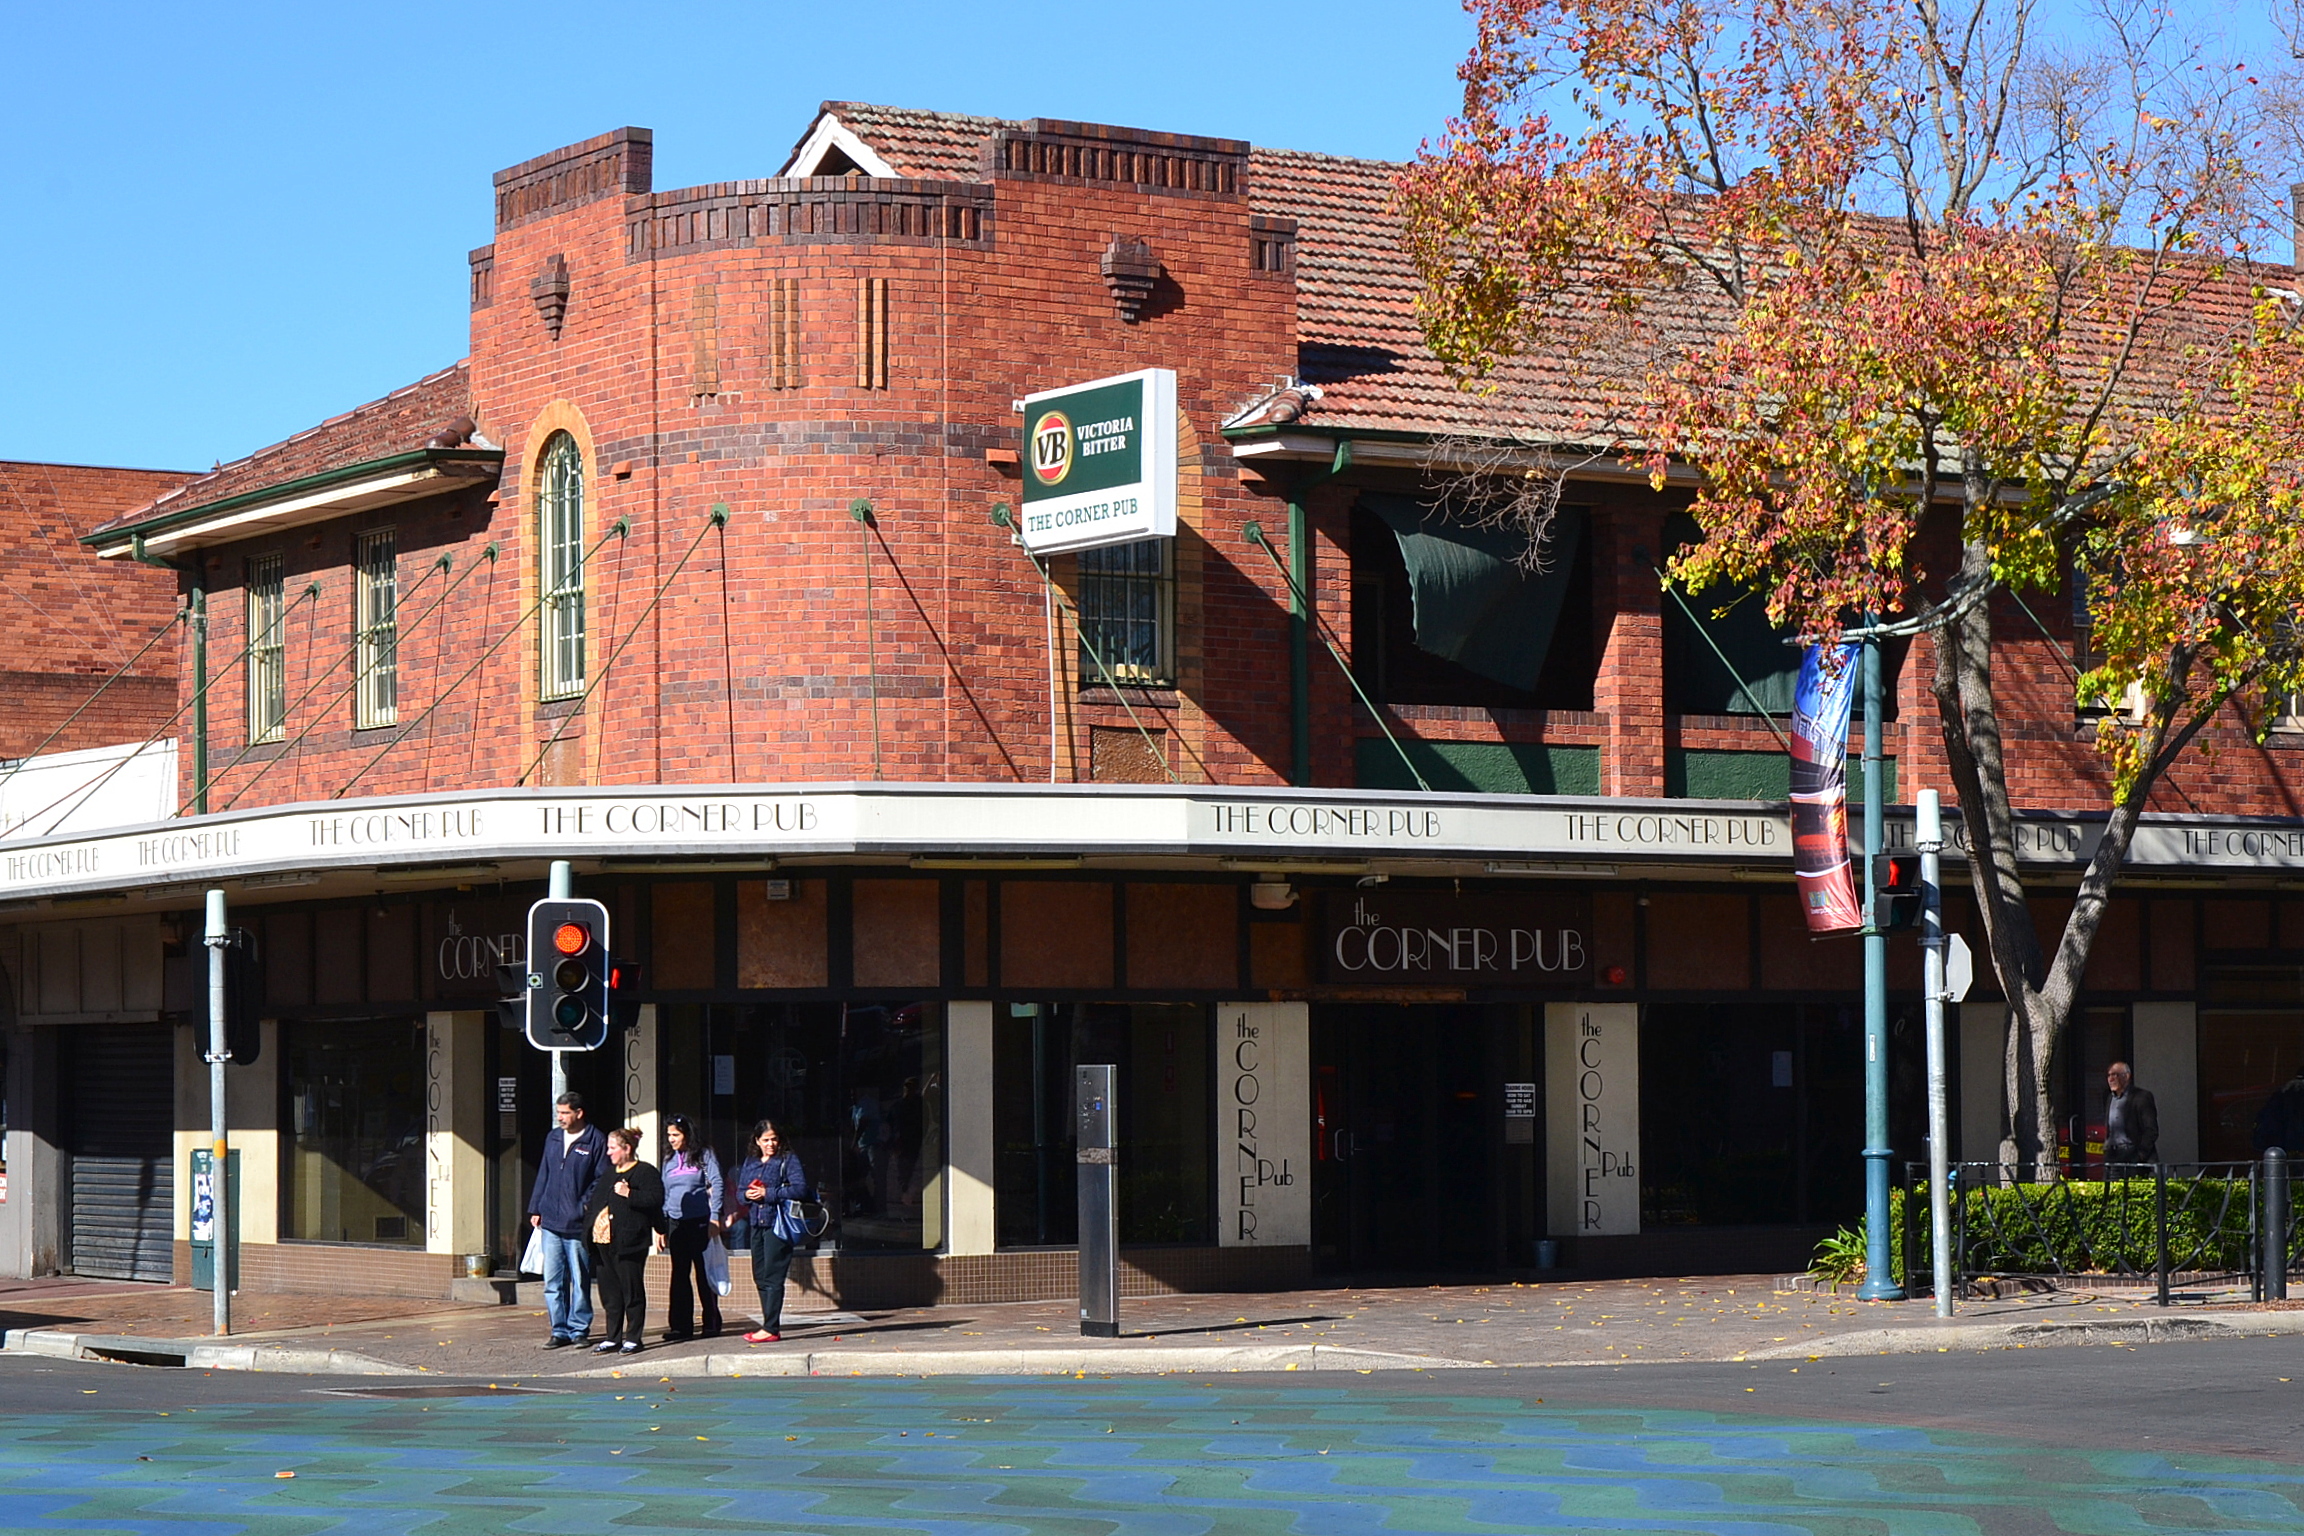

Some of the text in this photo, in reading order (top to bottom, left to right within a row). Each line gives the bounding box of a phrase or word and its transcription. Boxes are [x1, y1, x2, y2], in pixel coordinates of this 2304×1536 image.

[1077, 416, 1134, 441] VICTORIA
[1036, 430, 1067, 466] VB
[1082, 435, 1126, 457] BITTER
[1028, 498, 1138, 532] THE CORNER PUB
[309, 809, 484, 846] THE CORNER PUB
[537, 803, 817, 834] THE CORNER PUB
[1211, 805, 1441, 838] THE CORNER PUB
[1564, 814, 1775, 846] THE CORNER PUB
[1886, 823, 1915, 848] TH
[2037, 826, 2080, 852] PUB
[2182, 830, 2219, 855] THE
[7, 855, 26, 880] THE
[138, 840, 158, 866] THE
[448, 908, 462, 936] the
[1354, 897, 1380, 926] the
[1335, 926, 1586, 971] CORNER PUB
[429, 1025, 441, 1049] the
[1236, 1013, 1259, 1038] the
[1581, 1013, 1602, 1036] the
[428, 1050, 441, 1240] CORNER
[1235, 1040, 1259, 1240] CORNER
[1580, 1039, 1602, 1230] CORNER
[1258, 1159, 1294, 1186] Pub
[1602, 1151, 1635, 1177] Pub
